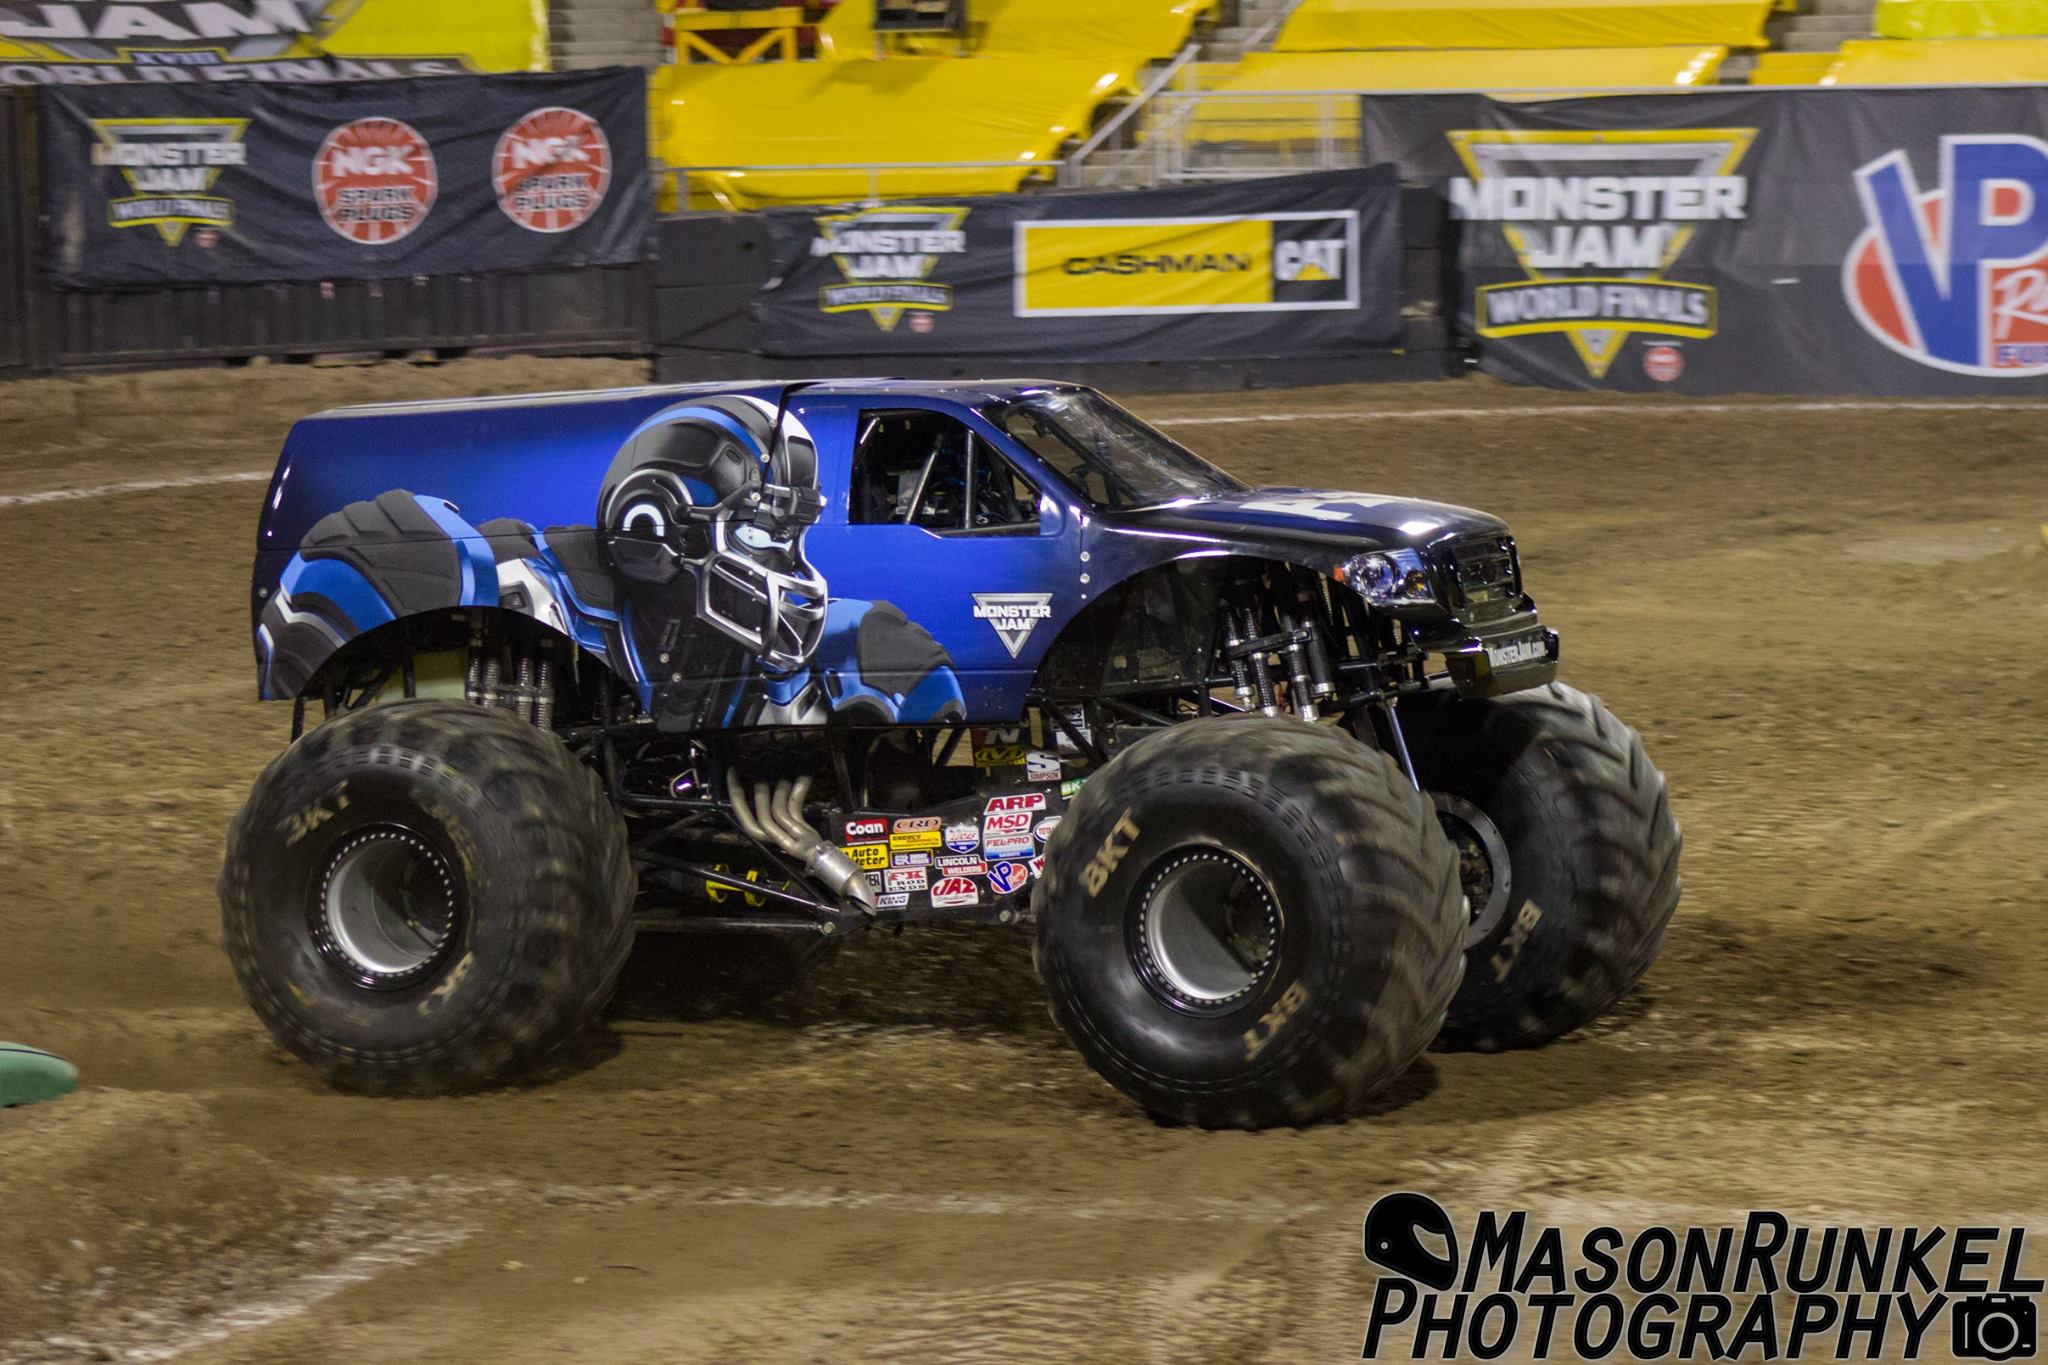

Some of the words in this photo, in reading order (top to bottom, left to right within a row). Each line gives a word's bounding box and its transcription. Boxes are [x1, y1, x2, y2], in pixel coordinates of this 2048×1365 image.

[0, 0, 311, 40] JAM
[90, 142, 247, 166] MONSTER
[330, 146, 415, 177] NGK
[512, 137, 591, 169] NGK
[136, 167, 207, 191] JAM
[519, 173, 591, 195] SPARK
[339, 187, 415, 204] SPARK
[516, 191, 588, 211] PLUGS
[1450, 176, 1747, 220] MONSTER
[337, 204, 415, 224] PLUGS
[809, 230, 967, 257] MONSTER
[1528, 225, 1663, 268] JAM
[1852, 135, 2048, 368] VP
[848, 254, 925, 278] JAM
[1063, 253, 1251, 275] CASHMAN
[1274, 240, 1346, 280] CAT
[1487, 286, 1600, 324] WORLD
[1601, 286, 1708, 325] FINALS
[973, 605, 1052, 618] MONSTER
[996, 618, 1031, 630] JAM
[1029, 772, 1060, 780] SIMPSON
[988, 795, 1044, 811] ARP
[846, 821, 884, 835] Coan
[987, 814, 1029, 829] MSD
[852, 848, 879, 858] Auto
[937, 857, 977, 867] LINCOLN
[1080, 808, 1141, 897] BKT
[890, 871, 923, 880] FK
[947, 865, 982, 875] WELDERS
[988, 861, 1013, 892] VP
[933, 878, 976, 896] JAZ
